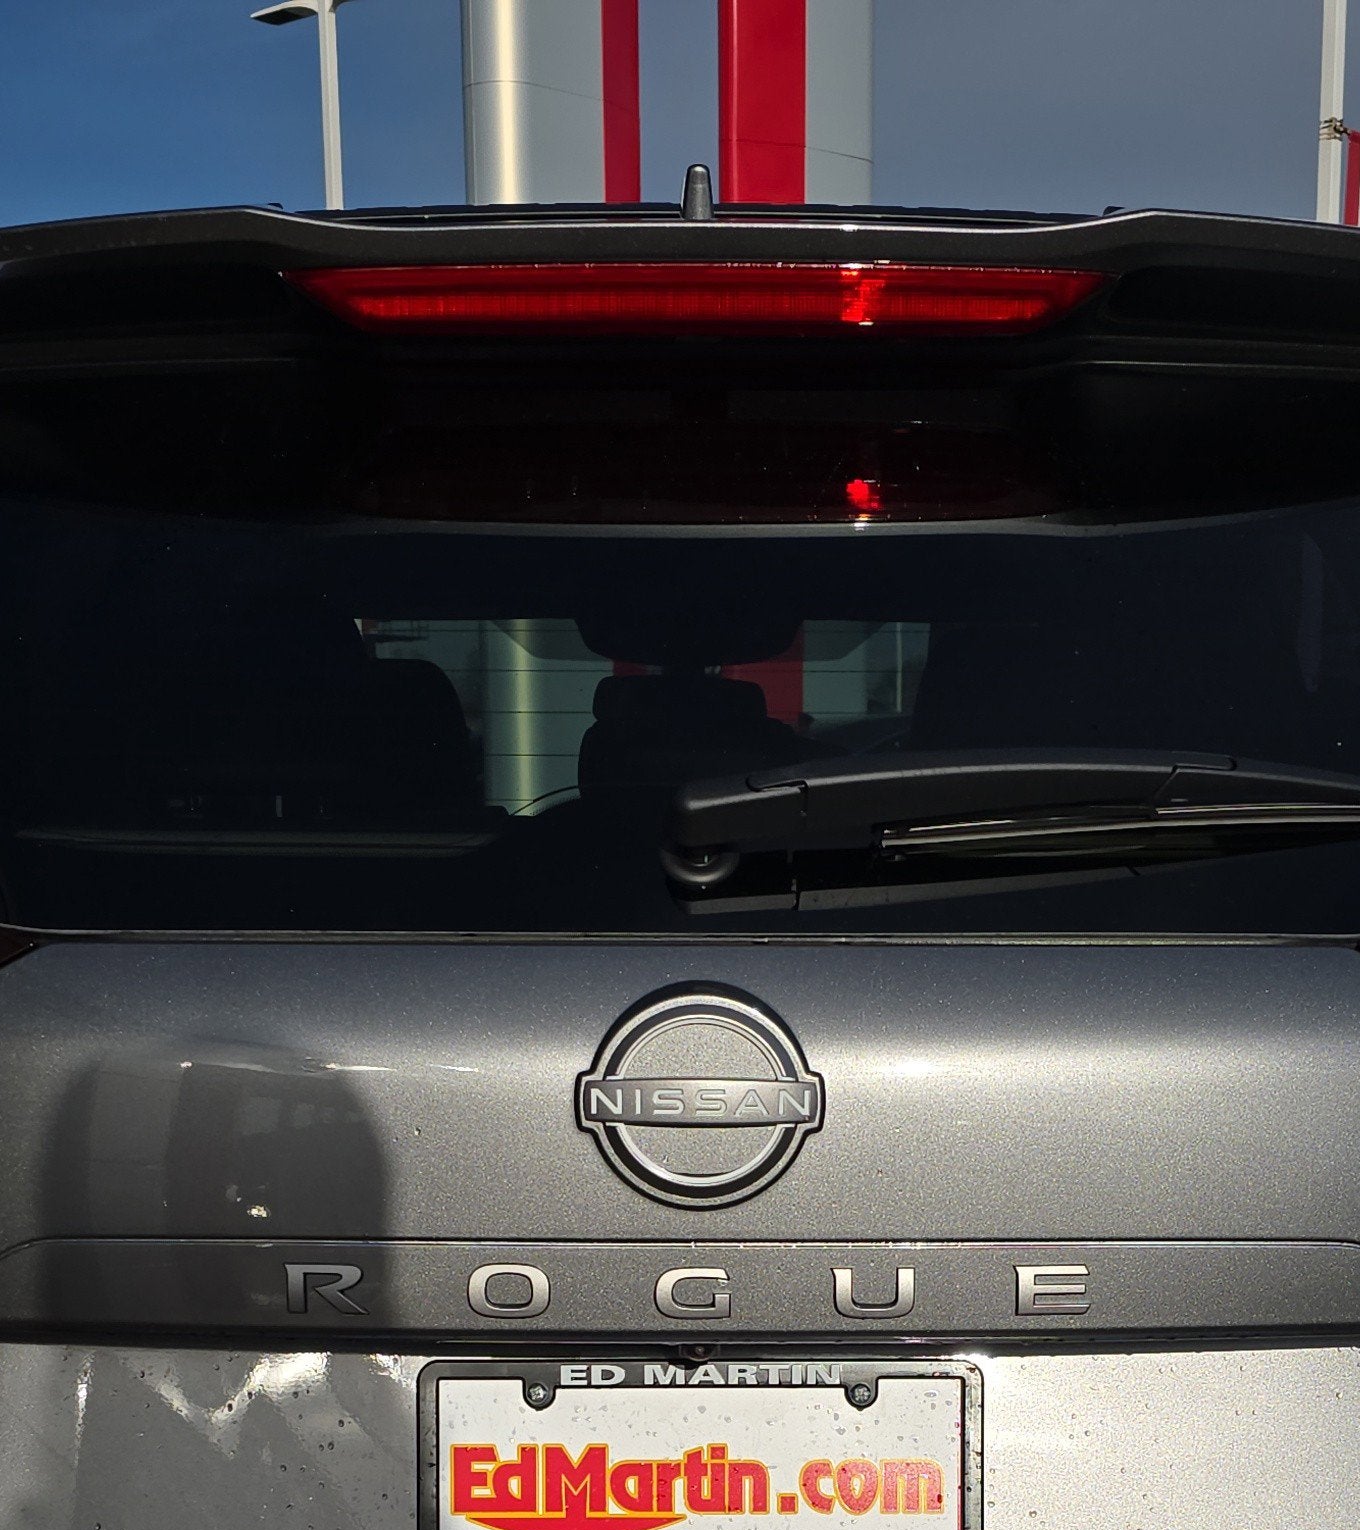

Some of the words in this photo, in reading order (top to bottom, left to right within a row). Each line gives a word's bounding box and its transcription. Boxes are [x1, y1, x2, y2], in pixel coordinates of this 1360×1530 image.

[590, 1087, 811, 1117] NISSAN
[284, 1261, 1092, 1320] ROGUE
[560, 1365, 626, 1387] ED
[643, 1363, 843, 1386] MARTIN
[449, 1443, 946, 1517] EdMartin.com
